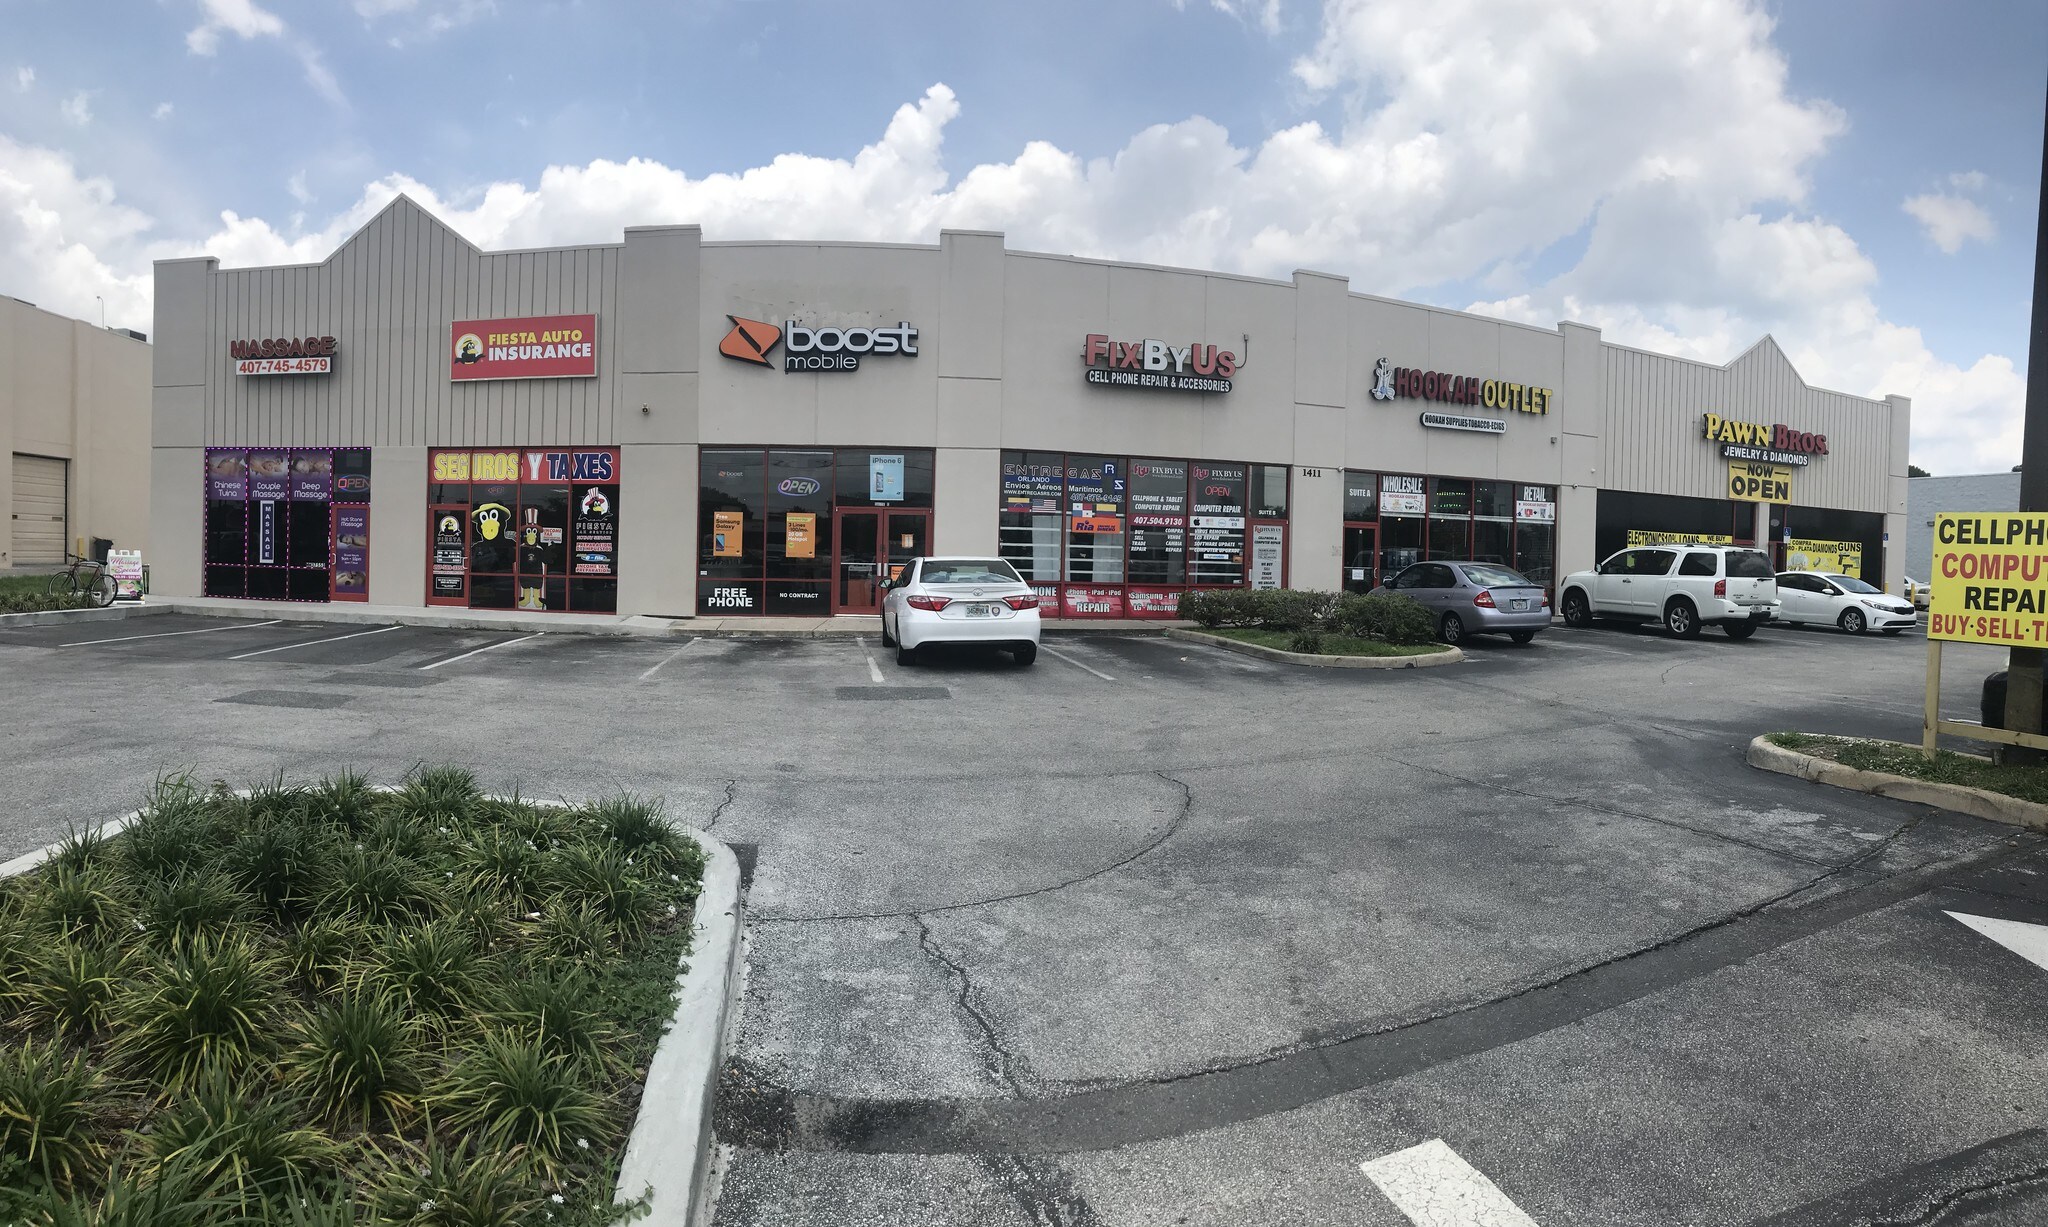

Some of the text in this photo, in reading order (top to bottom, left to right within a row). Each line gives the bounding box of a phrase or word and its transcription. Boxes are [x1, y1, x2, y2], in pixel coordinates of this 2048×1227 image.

[488, 330, 582, 346] FIESTA AUTO
[786, 320, 918, 355] boost
[230, 336, 336, 358] MASSAGE
[488, 343, 592, 361] INSURANCE
[239, 359, 328, 374] 407-745-4579
[786, 354, 857, 369] mobile
[1089, 370, 1230, 392] CELL PHONE REPAIR & ACCESSORIES
[1394, 367, 1552, 415] HOOKAH OUTLET
[1424, 414, 1446, 425] HOOKAH
[1703, 413, 1771, 448] PAWN
[1724, 446, 1808, 466] JEWELRY & DIAMONDS
[434, 452, 613, 481] SEGUROS Y TAXES
[1105, 464, 1114, 474] R
[1747, 464, 1774, 478] NOW
[1302, 468, 1322, 478] 1411
[214, 481, 241, 489] Chinese
[256, 482, 281, 491] Couple
[301, 482, 320, 491] Deep
[338, 478, 370, 488] OPEN
[780, 479, 816, 494] OPEN
[1382, 476, 1422, 493] WHOLESALE
[1732, 476, 1789, 500] OPEN
[252, 490, 285, 500] Massage
[294, 490, 327, 500] Massage
[1205, 486, 1230, 496] OPEN
[1350, 488, 1366, 497] SUITE
[1524, 486, 1546, 501] RETAIL
[1194, 504, 1222, 513] COMPUTER
[1076, 520, 1094, 531] Ria
[1134, 516, 1183, 525] 407.504.9130
[1628, 530, 1665, 546] ELECTRONICS
[1680, 534, 1700, 544] LOANS
[1938, 519, 2048, 546] CELLPH
[1813, 542, 1861, 554] DIAMONDS GUNS
[714, 588, 747, 597] FREE
[1030, 587, 1057, 596] HONE
[1131, 592, 1165, 600] Samsung
[708, 597, 753, 607] PHONE
[1076, 602, 1110, 612] REPAIR
[1932, 613, 2048, 642] BUY SELL T
